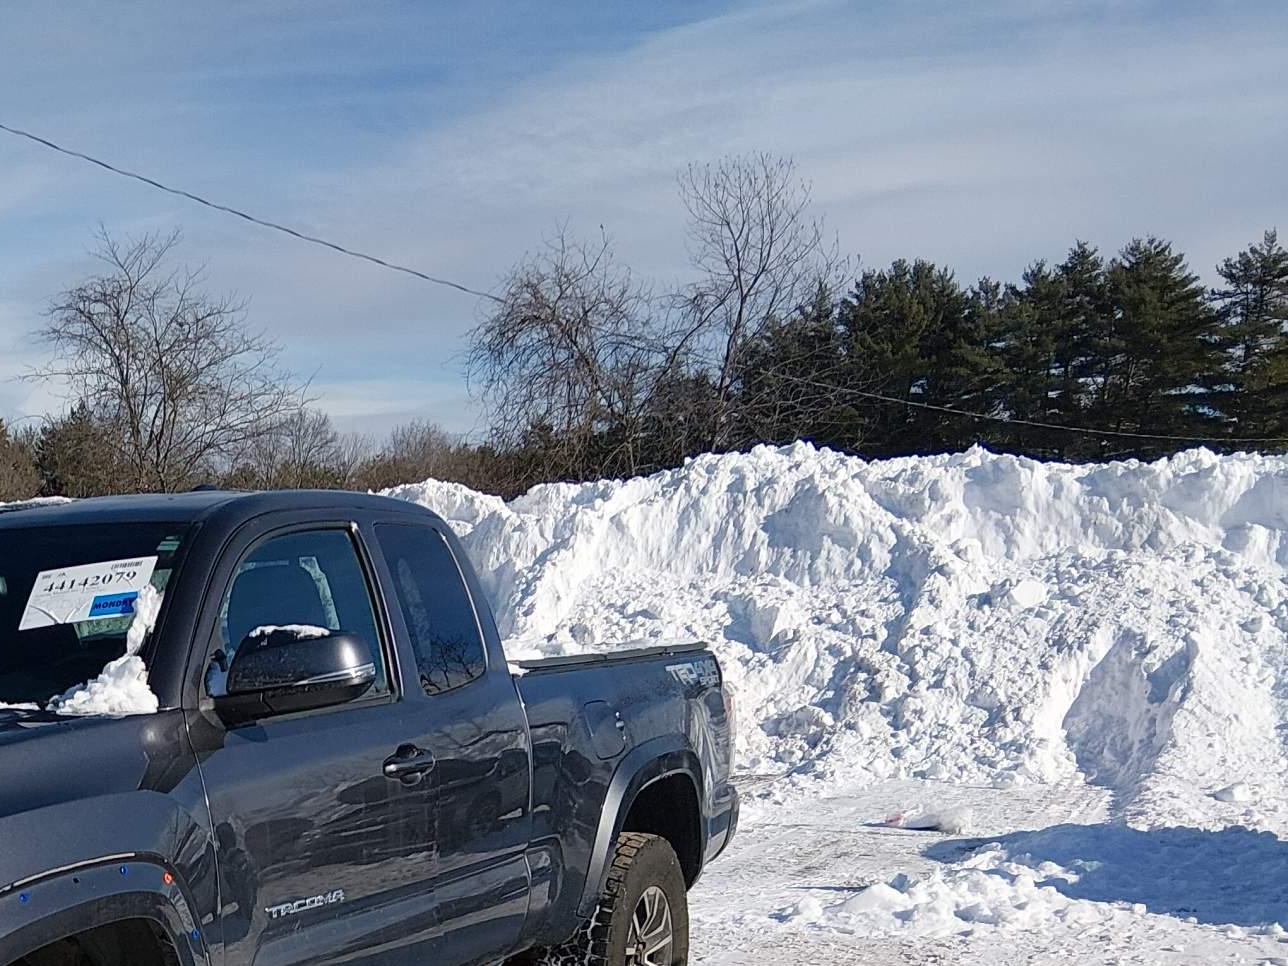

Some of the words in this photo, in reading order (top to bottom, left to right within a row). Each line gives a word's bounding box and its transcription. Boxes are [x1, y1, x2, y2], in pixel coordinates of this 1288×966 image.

[43, 571, 137, 592] 44142079
[665, 662, 697, 686] TRD
[265, 889, 345, 918] TACOMA
